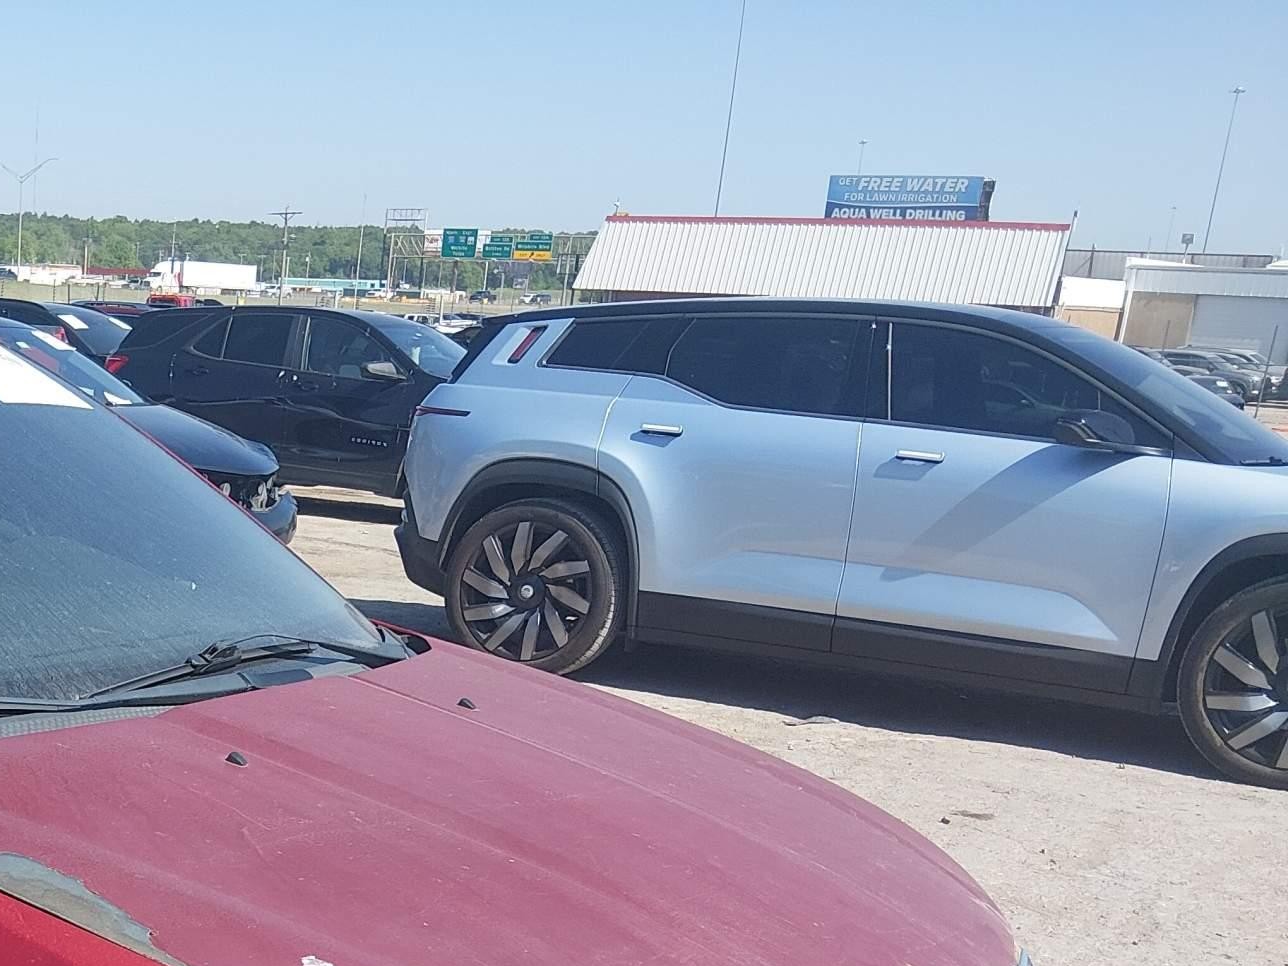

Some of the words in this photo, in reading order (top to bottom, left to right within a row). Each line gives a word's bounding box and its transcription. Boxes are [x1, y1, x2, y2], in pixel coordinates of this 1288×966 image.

[839, 178, 858, 186] GET
[858, 177, 904, 191] FREE
[906, 178, 969, 193] WATER
[844, 192, 865, 202] FOR
[866, 192, 897, 202] LAWN
[897, 193, 958, 203] IRRIGATION
[831, 207, 867, 219] AQUA
[869, 208, 903, 220] WELL
[906, 209, 966, 221] DRILLING
